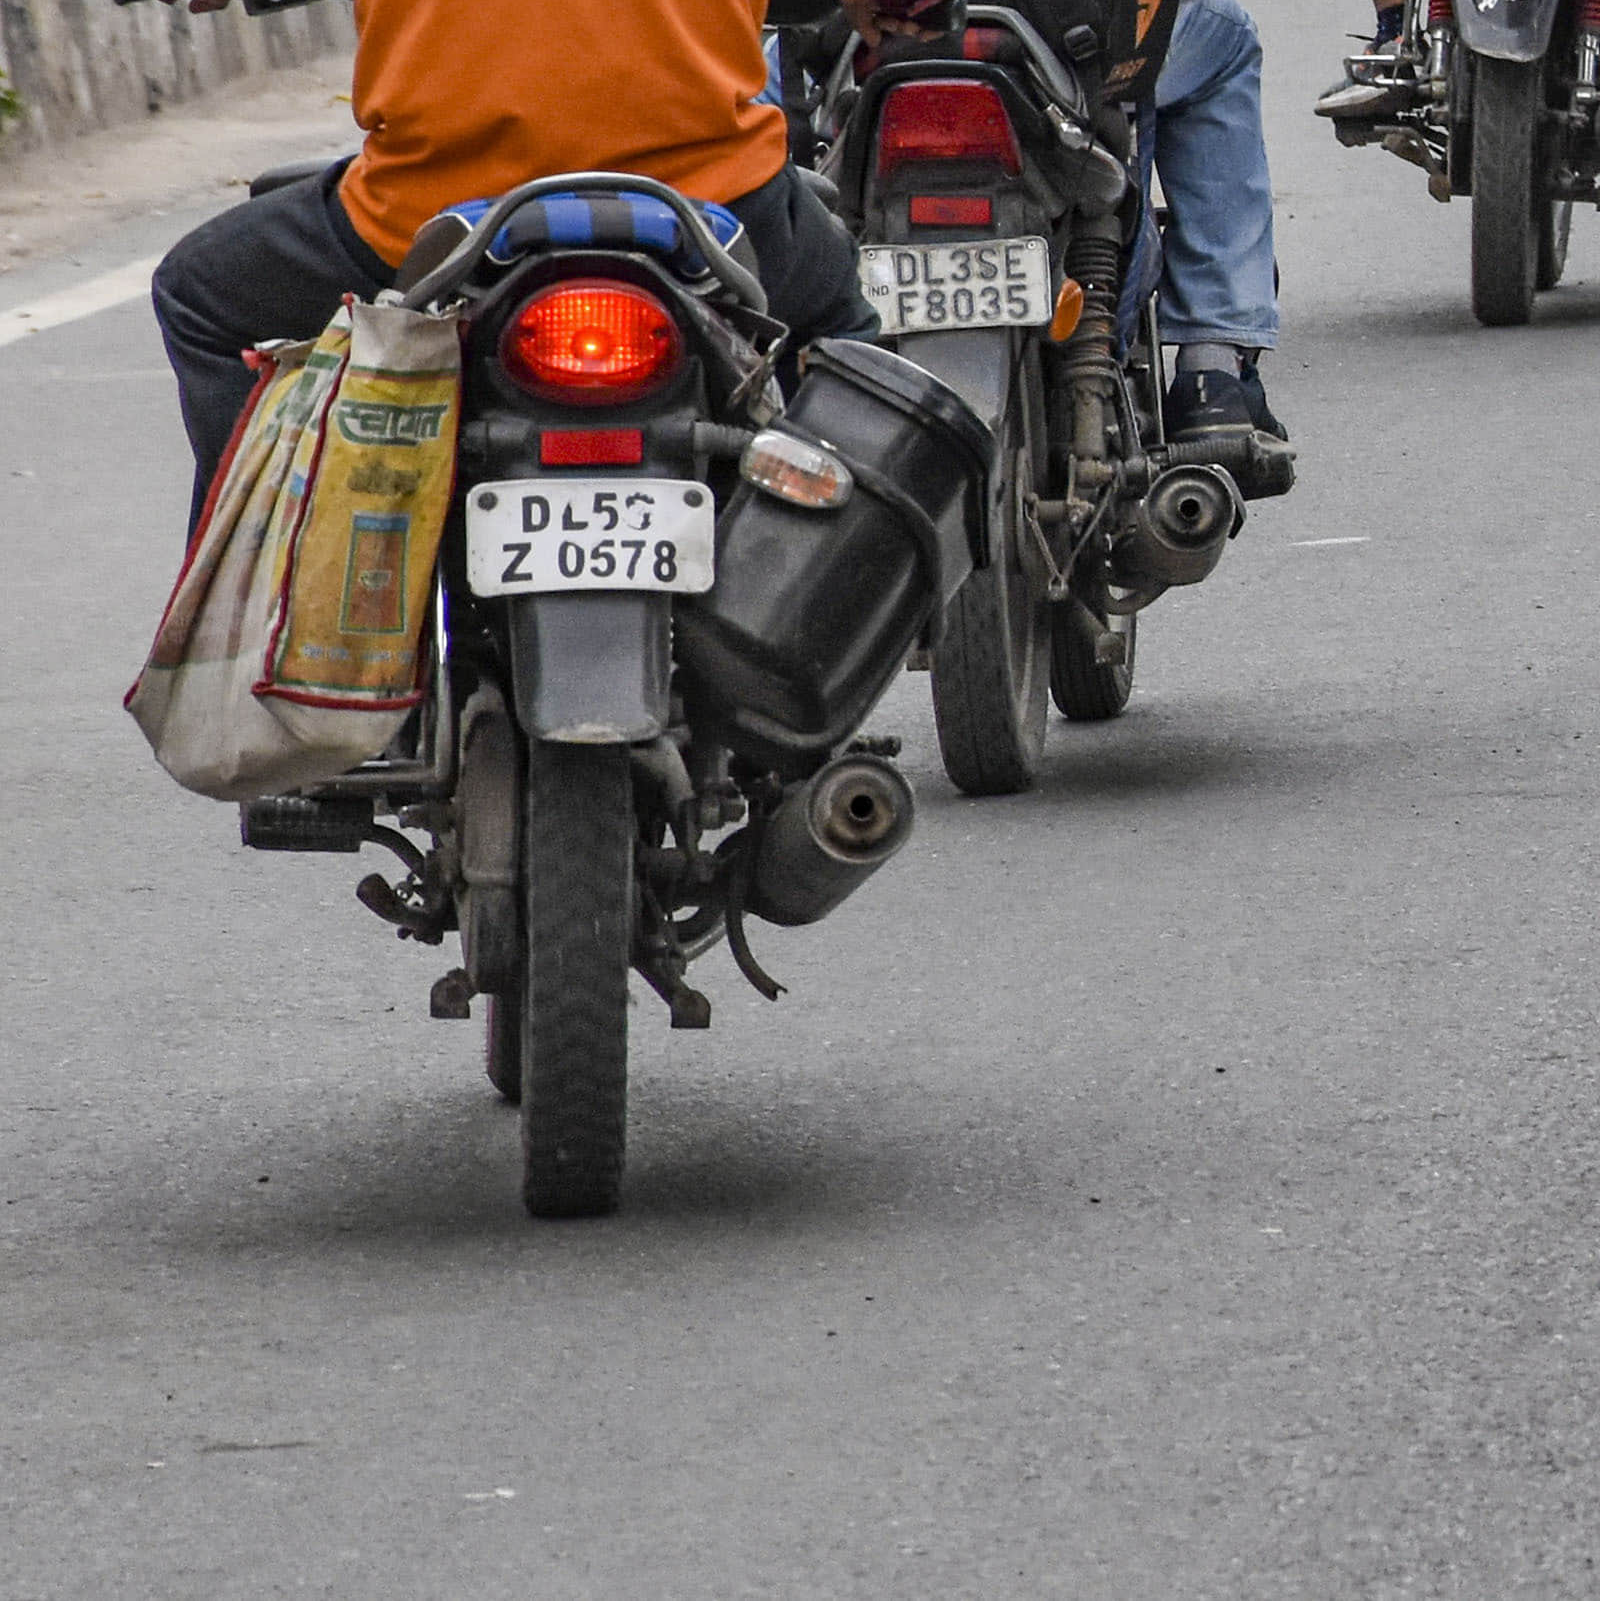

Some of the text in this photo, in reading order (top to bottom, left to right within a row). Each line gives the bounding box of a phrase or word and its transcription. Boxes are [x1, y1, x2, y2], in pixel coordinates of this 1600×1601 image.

[896, 245, 1027, 286] DL3SE
[867, 285, 889, 296] IND
[897, 284, 1029, 327] F8035
[501, 540, 678, 583] Z 0578
